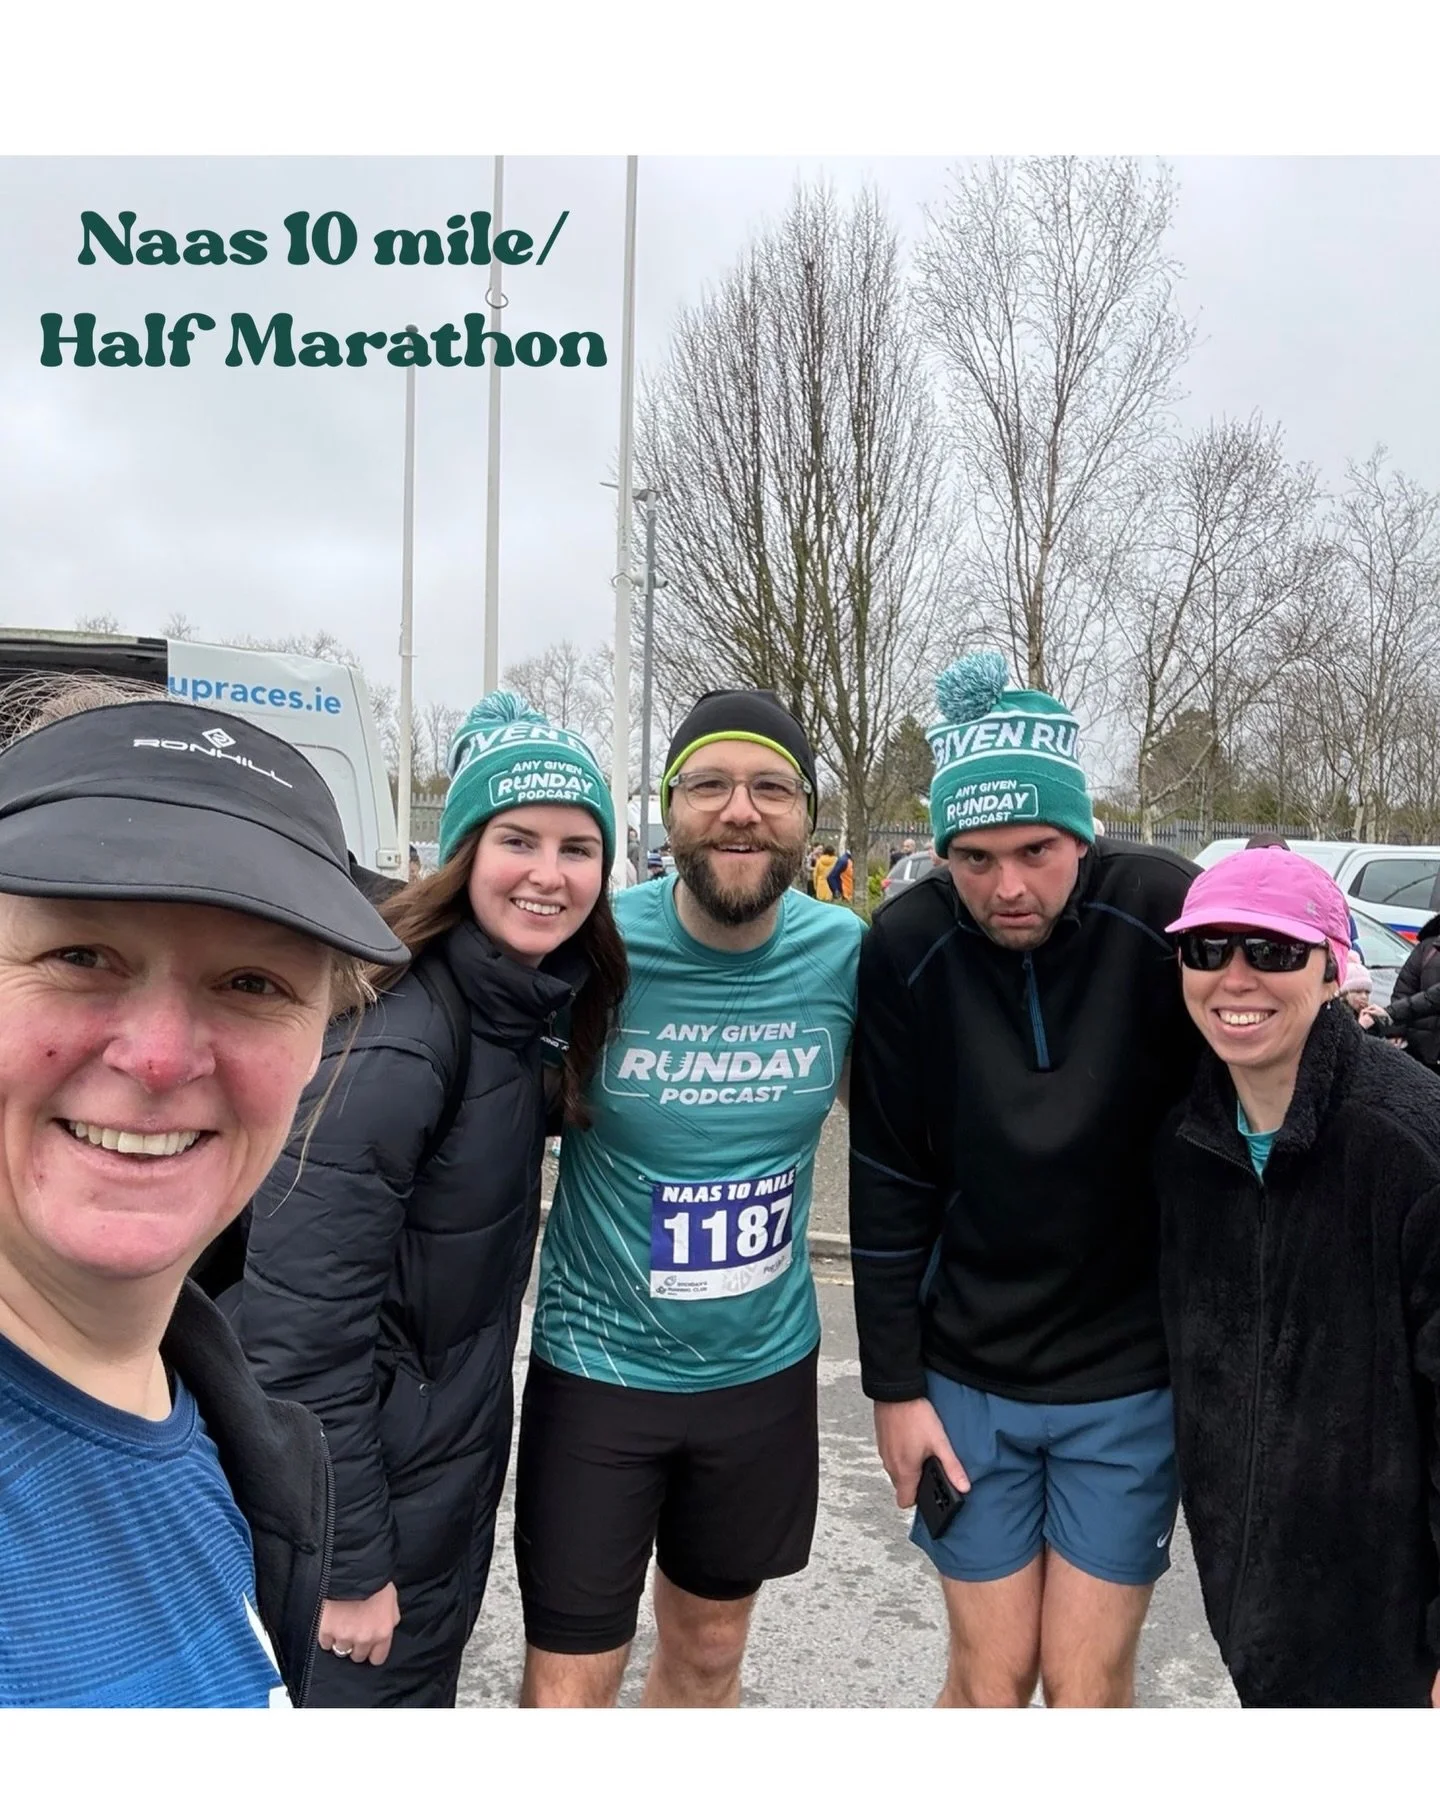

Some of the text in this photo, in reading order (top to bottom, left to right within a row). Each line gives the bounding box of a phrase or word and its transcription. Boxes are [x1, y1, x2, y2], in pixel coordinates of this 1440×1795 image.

[168, 676, 341, 714] upraces.ie
[930, 721, 1077, 768] GIVEN RU
[133, 738, 293, 789] RONHILL
[512, 760, 583, 775] ANY GIVEN
[497, 773, 592, 796] RUNDAY
[518, 788, 580, 802] PODCAST
[955, 779, 1017, 798] ANY GIVEN
[946, 792, 1029, 822] RUNDAY
[958, 811, 1011, 829] PODCAST
[656, 1022, 797, 1043] ANY GIVEN
[617, 1045, 821, 1083] RUNDAY
[659, 1085, 788, 1105] PODCAST
[662, 1169, 796, 1203] NAAS 10 MILE
[663, 1193, 793, 1264] 1187
